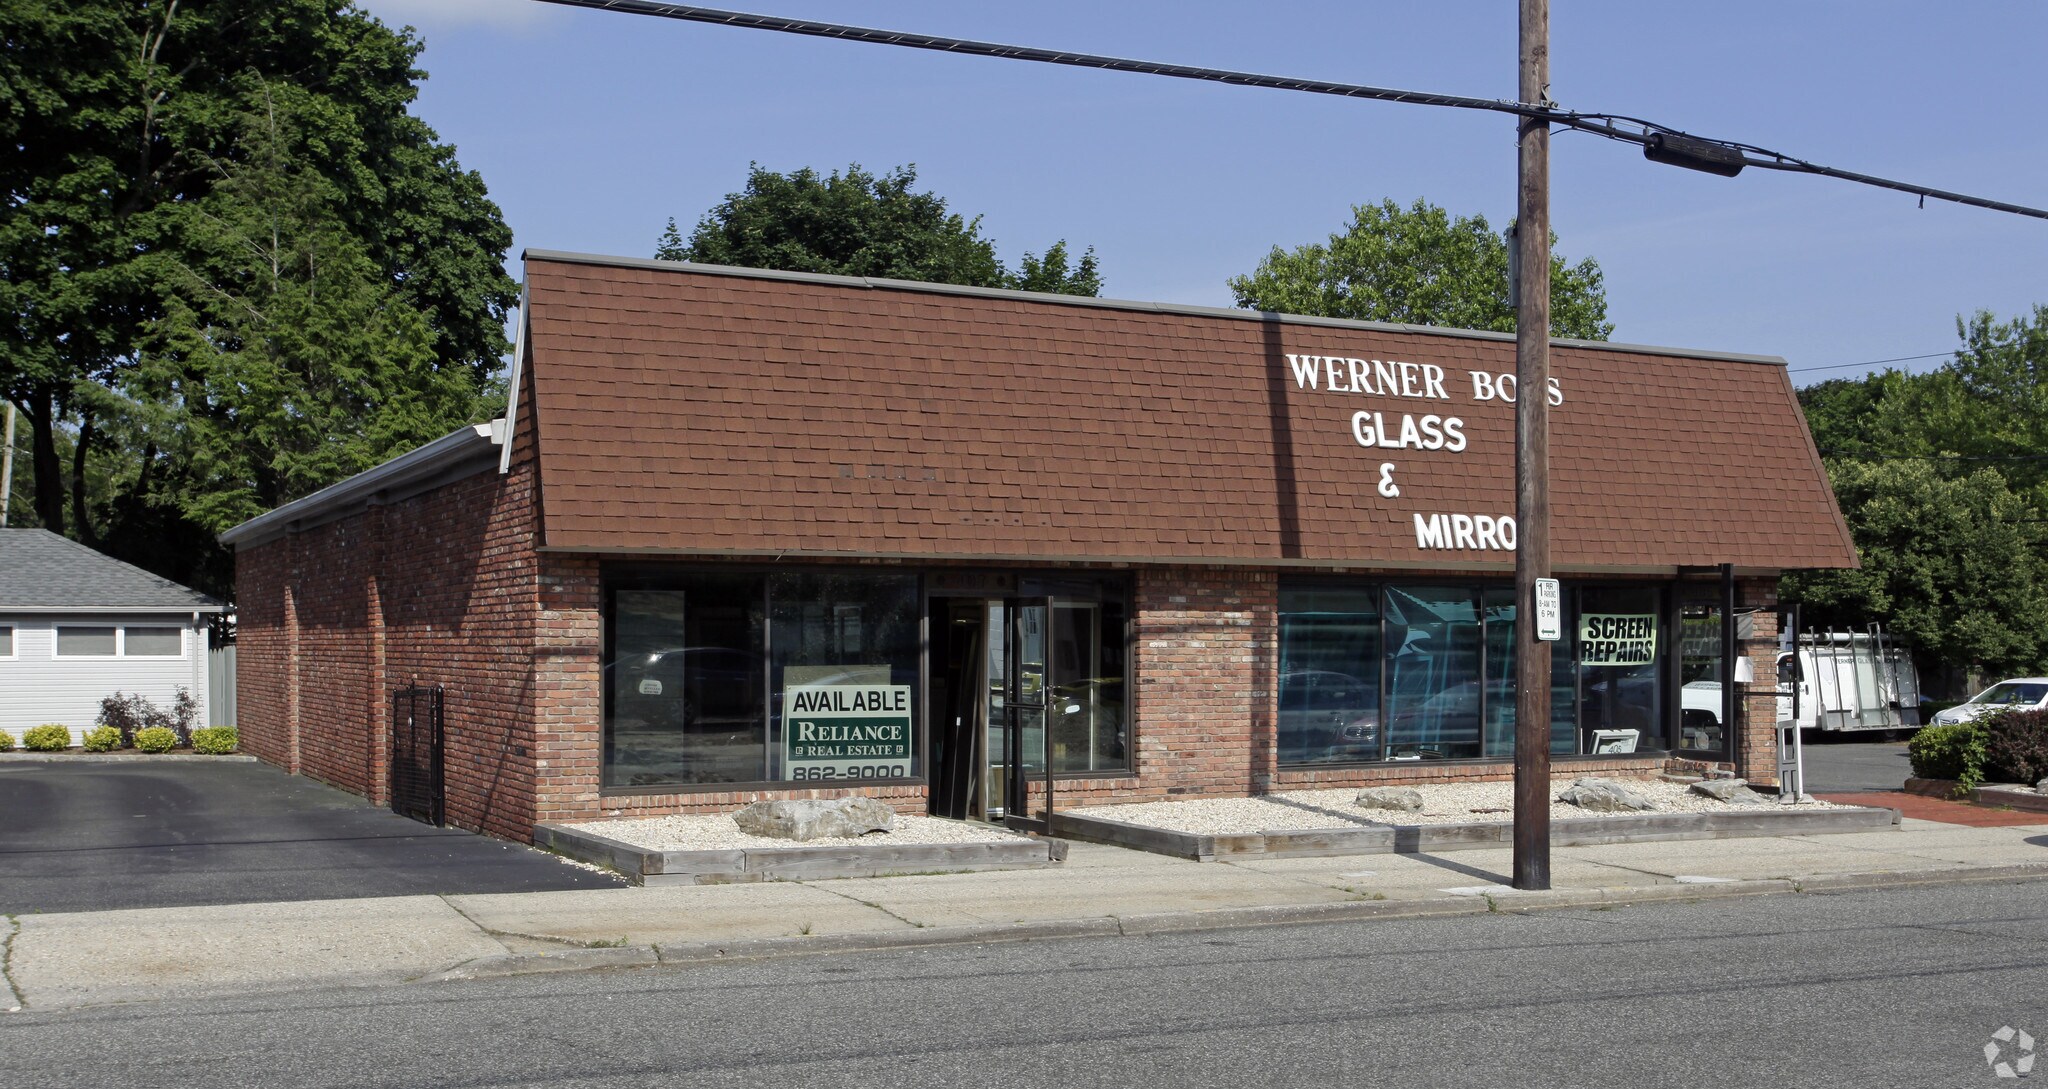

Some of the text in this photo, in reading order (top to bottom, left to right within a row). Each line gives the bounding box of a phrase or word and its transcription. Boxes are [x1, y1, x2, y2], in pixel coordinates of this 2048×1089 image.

[1286, 354, 1563, 406] WERNER BOS
[1351, 411, 1467, 453] GLASS
[1377, 462, 1400, 498] &
[1413, 513, 1517, 551] MIRRO
[1538, 582, 1543, 596] 1
[1541, 610, 1555, 618] 6 PM
[1588, 616, 1653, 640] SCREEN
[1580, 640, 1653, 663] REPAIRS
[793, 691, 906, 712] AVAILABLE
[797, 722, 902, 741] RELIANCE
[807, 744, 892, 756] REAL ESTATE
[792, 764, 905, 781] 862-9000
